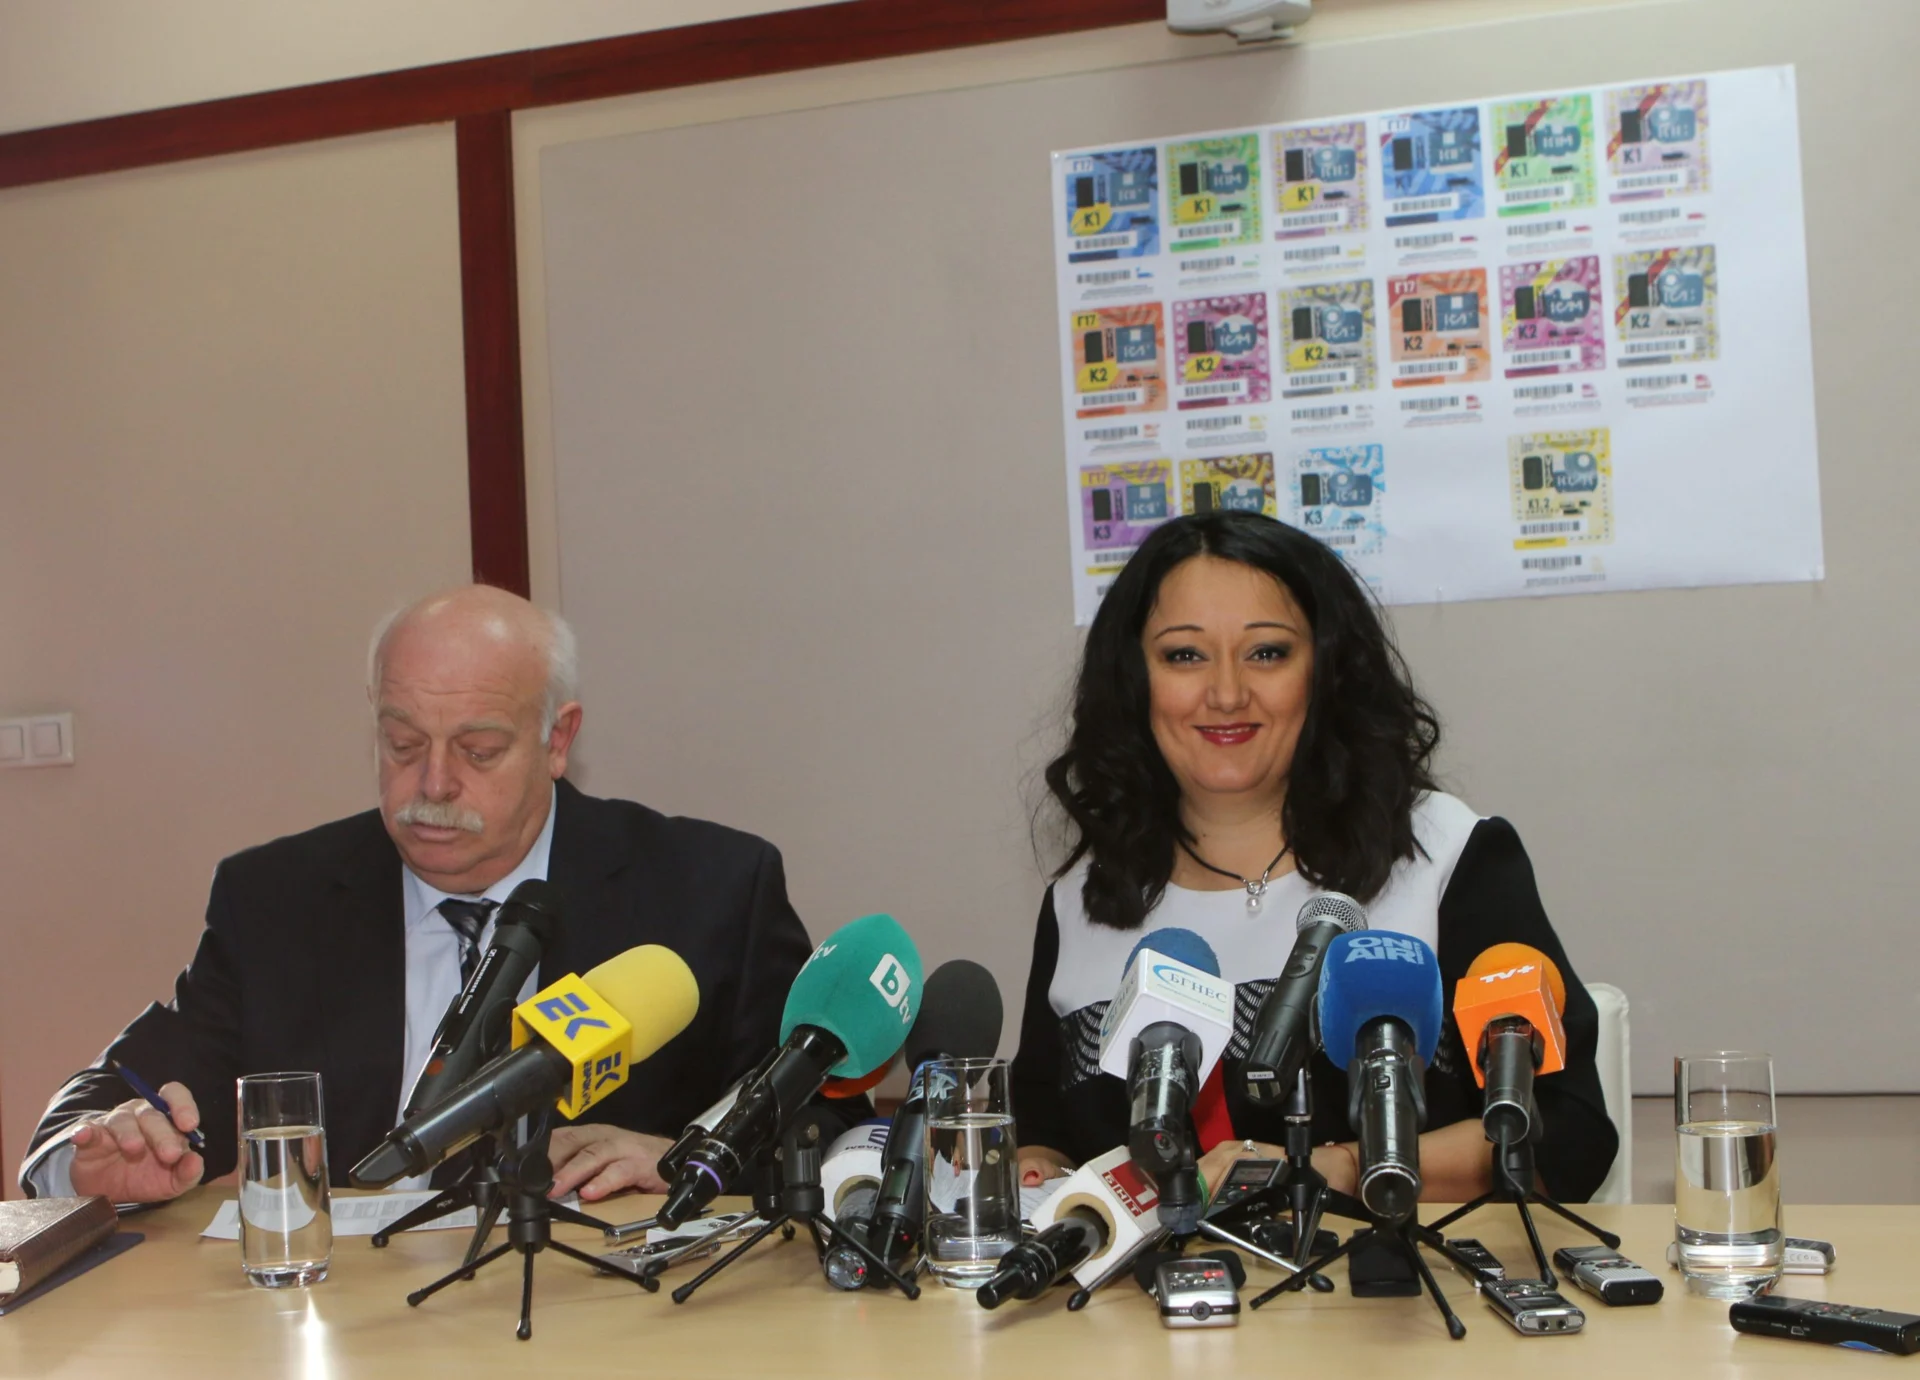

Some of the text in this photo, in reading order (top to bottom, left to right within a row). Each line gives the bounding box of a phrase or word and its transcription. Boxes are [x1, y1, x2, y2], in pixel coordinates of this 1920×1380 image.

[1347, 936, 1413, 950] ON
[1344, 946, 1418, 965] AIR
[1169, 971, 1229, 1004] БГНЕС
